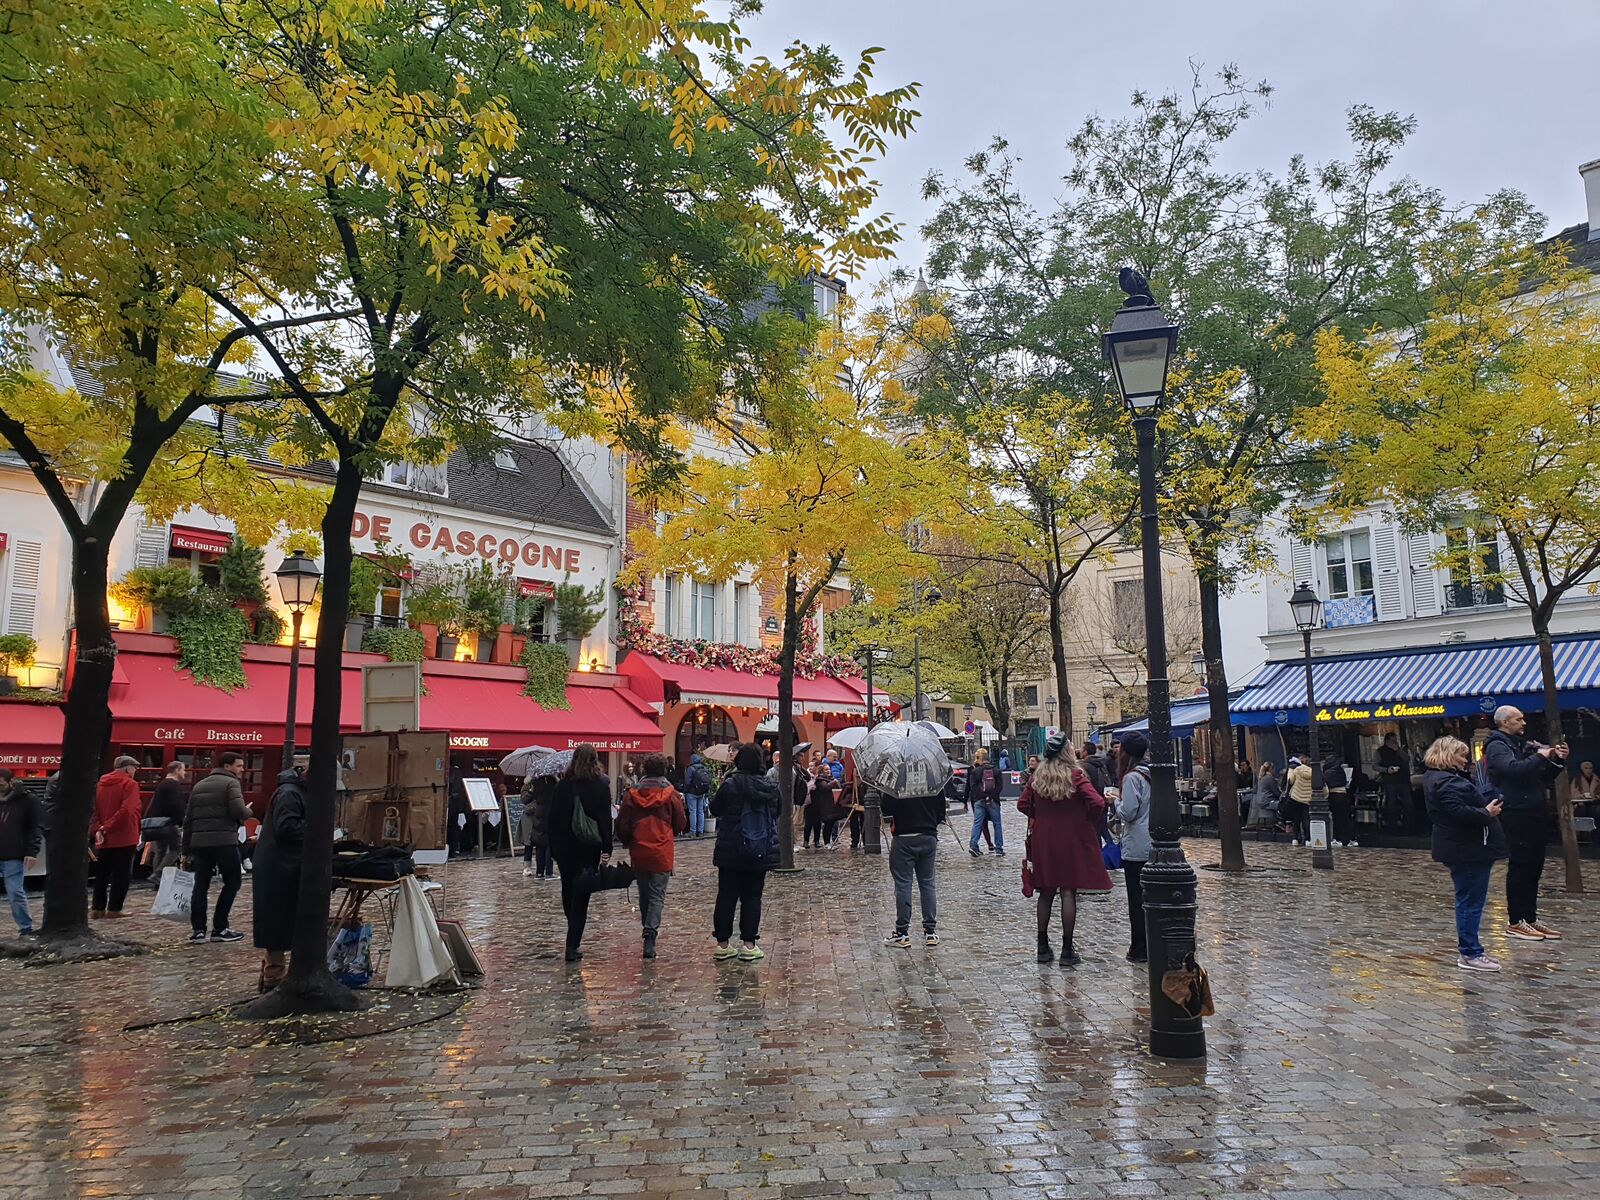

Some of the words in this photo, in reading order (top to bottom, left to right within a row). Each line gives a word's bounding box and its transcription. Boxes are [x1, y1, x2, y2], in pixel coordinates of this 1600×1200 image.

[352, 512, 391, 542] DE
[409, 523, 580, 572] GASCOGNE
[1315, 709, 1331, 721] Au
[1334, 708, 1370, 720] Clairon
[1374, 706, 1391, 717] des
[1393, 704, 1445, 716] Chasseurs
[154, 728, 185, 739] Café
[207, 730, 262, 741] Brasserie
[449, 737, 489, 746] ASCOGNE
[568, 739, 607, 748] Restrant
[610, 741, 624, 749] salle
[27, 756, 37, 764] EN
